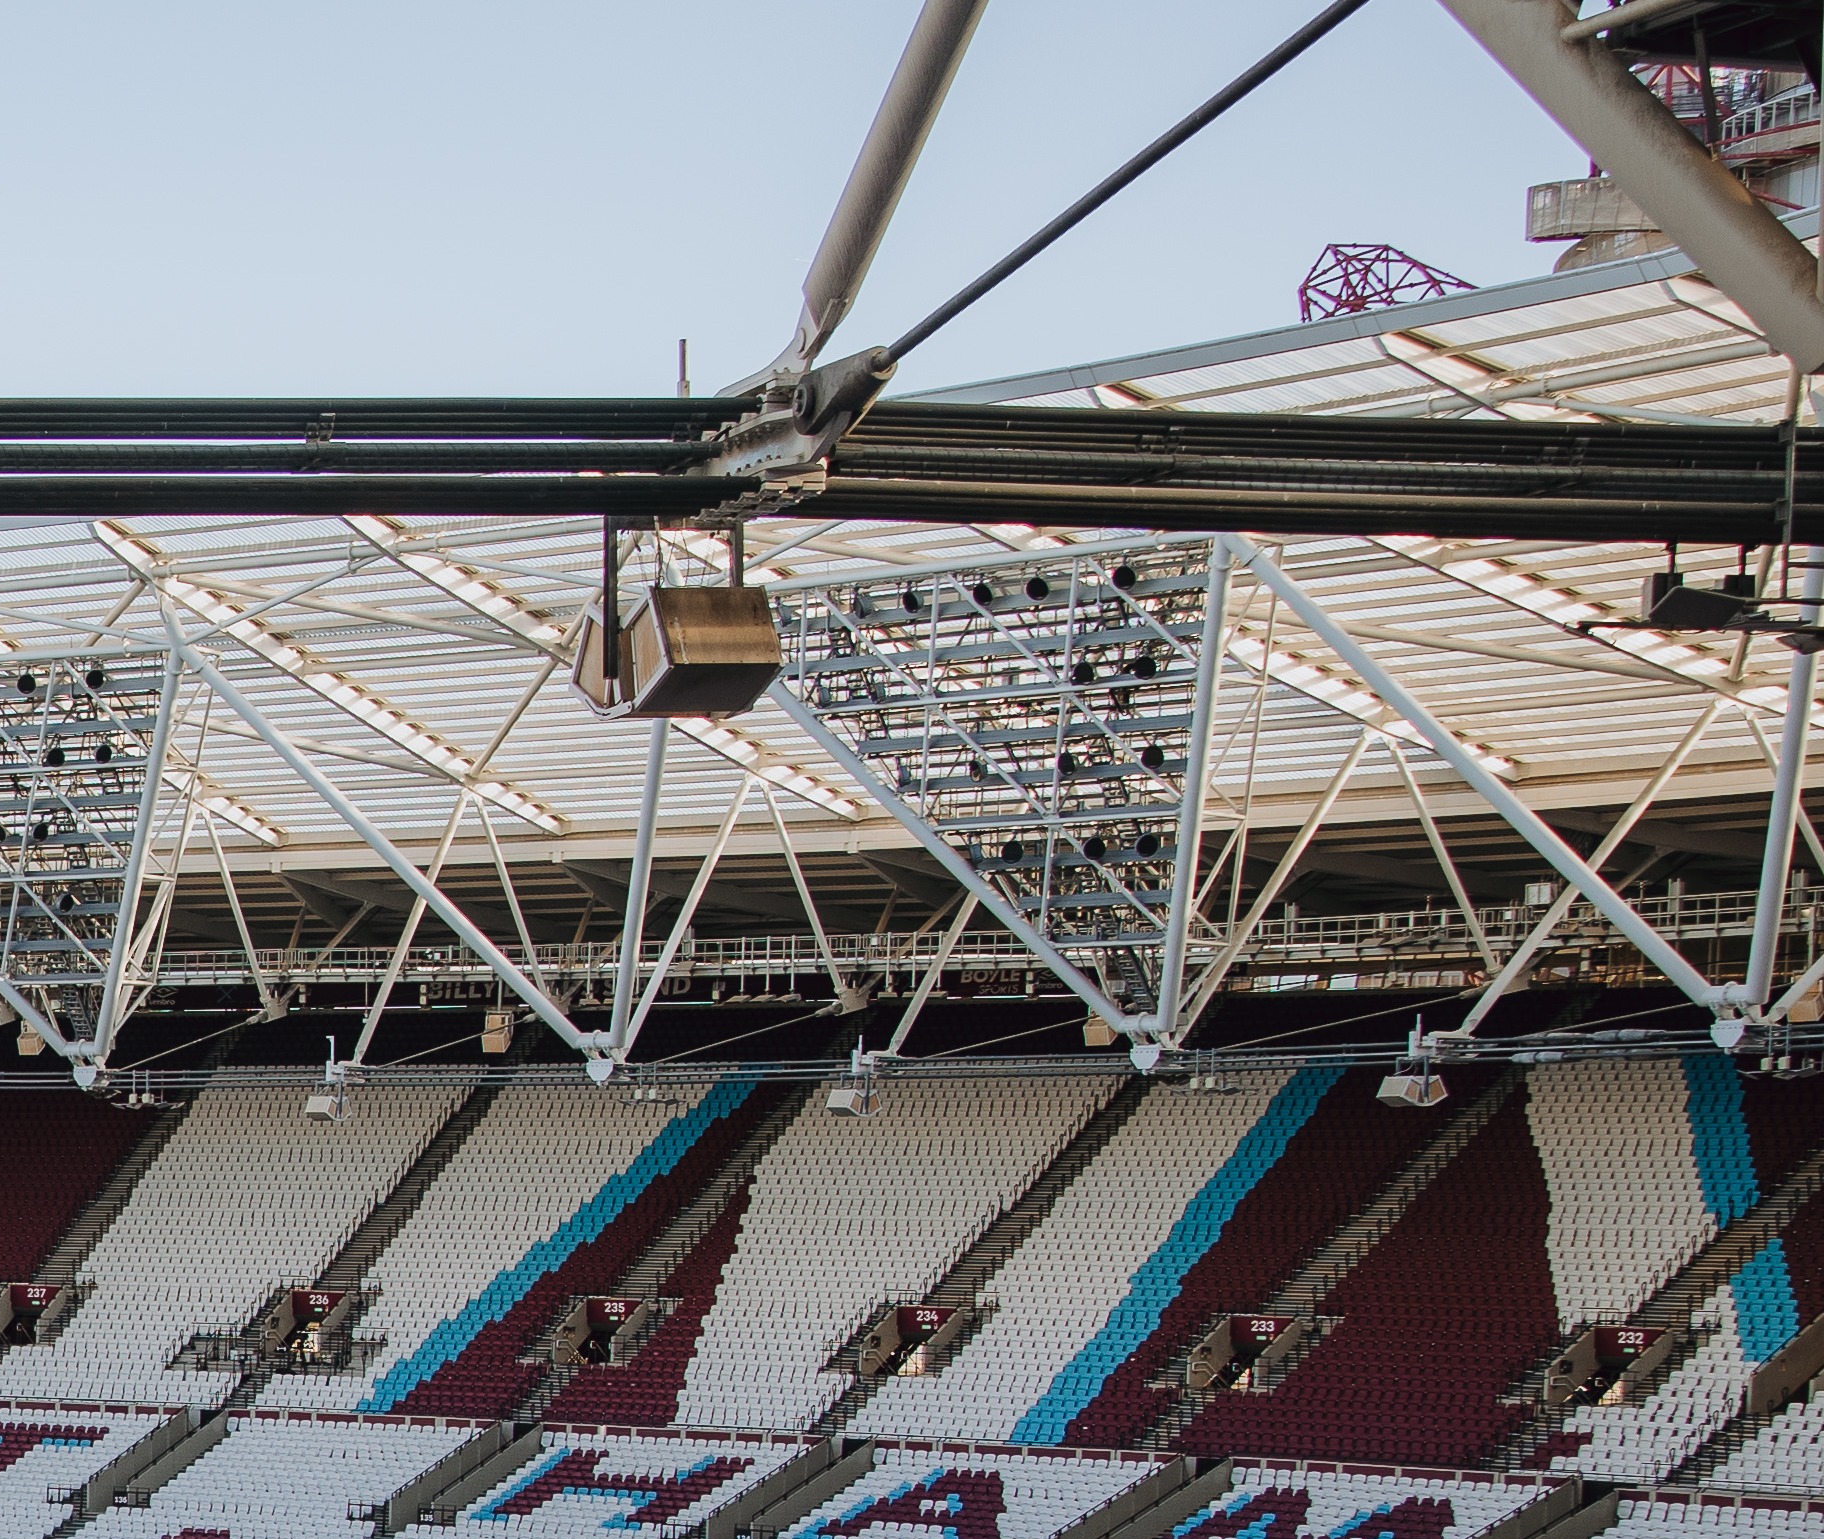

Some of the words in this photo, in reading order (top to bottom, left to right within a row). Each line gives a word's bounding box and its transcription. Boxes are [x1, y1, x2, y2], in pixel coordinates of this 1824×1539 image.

[960, 970, 1021, 985] BOYLE
[428, 982, 496, 999] BILLY
[978, 984, 1019, 995] SPORTS
[27, 1288, 46, 1297] 237
[310, 1295, 328, 1305] 236
[605, 1302, 625, 1313] 235
[917, 1311, 938, 1321] 234
[1251, 1320, 1274, 1331] 233
[1618, 1332, 1643, 1344] 232
